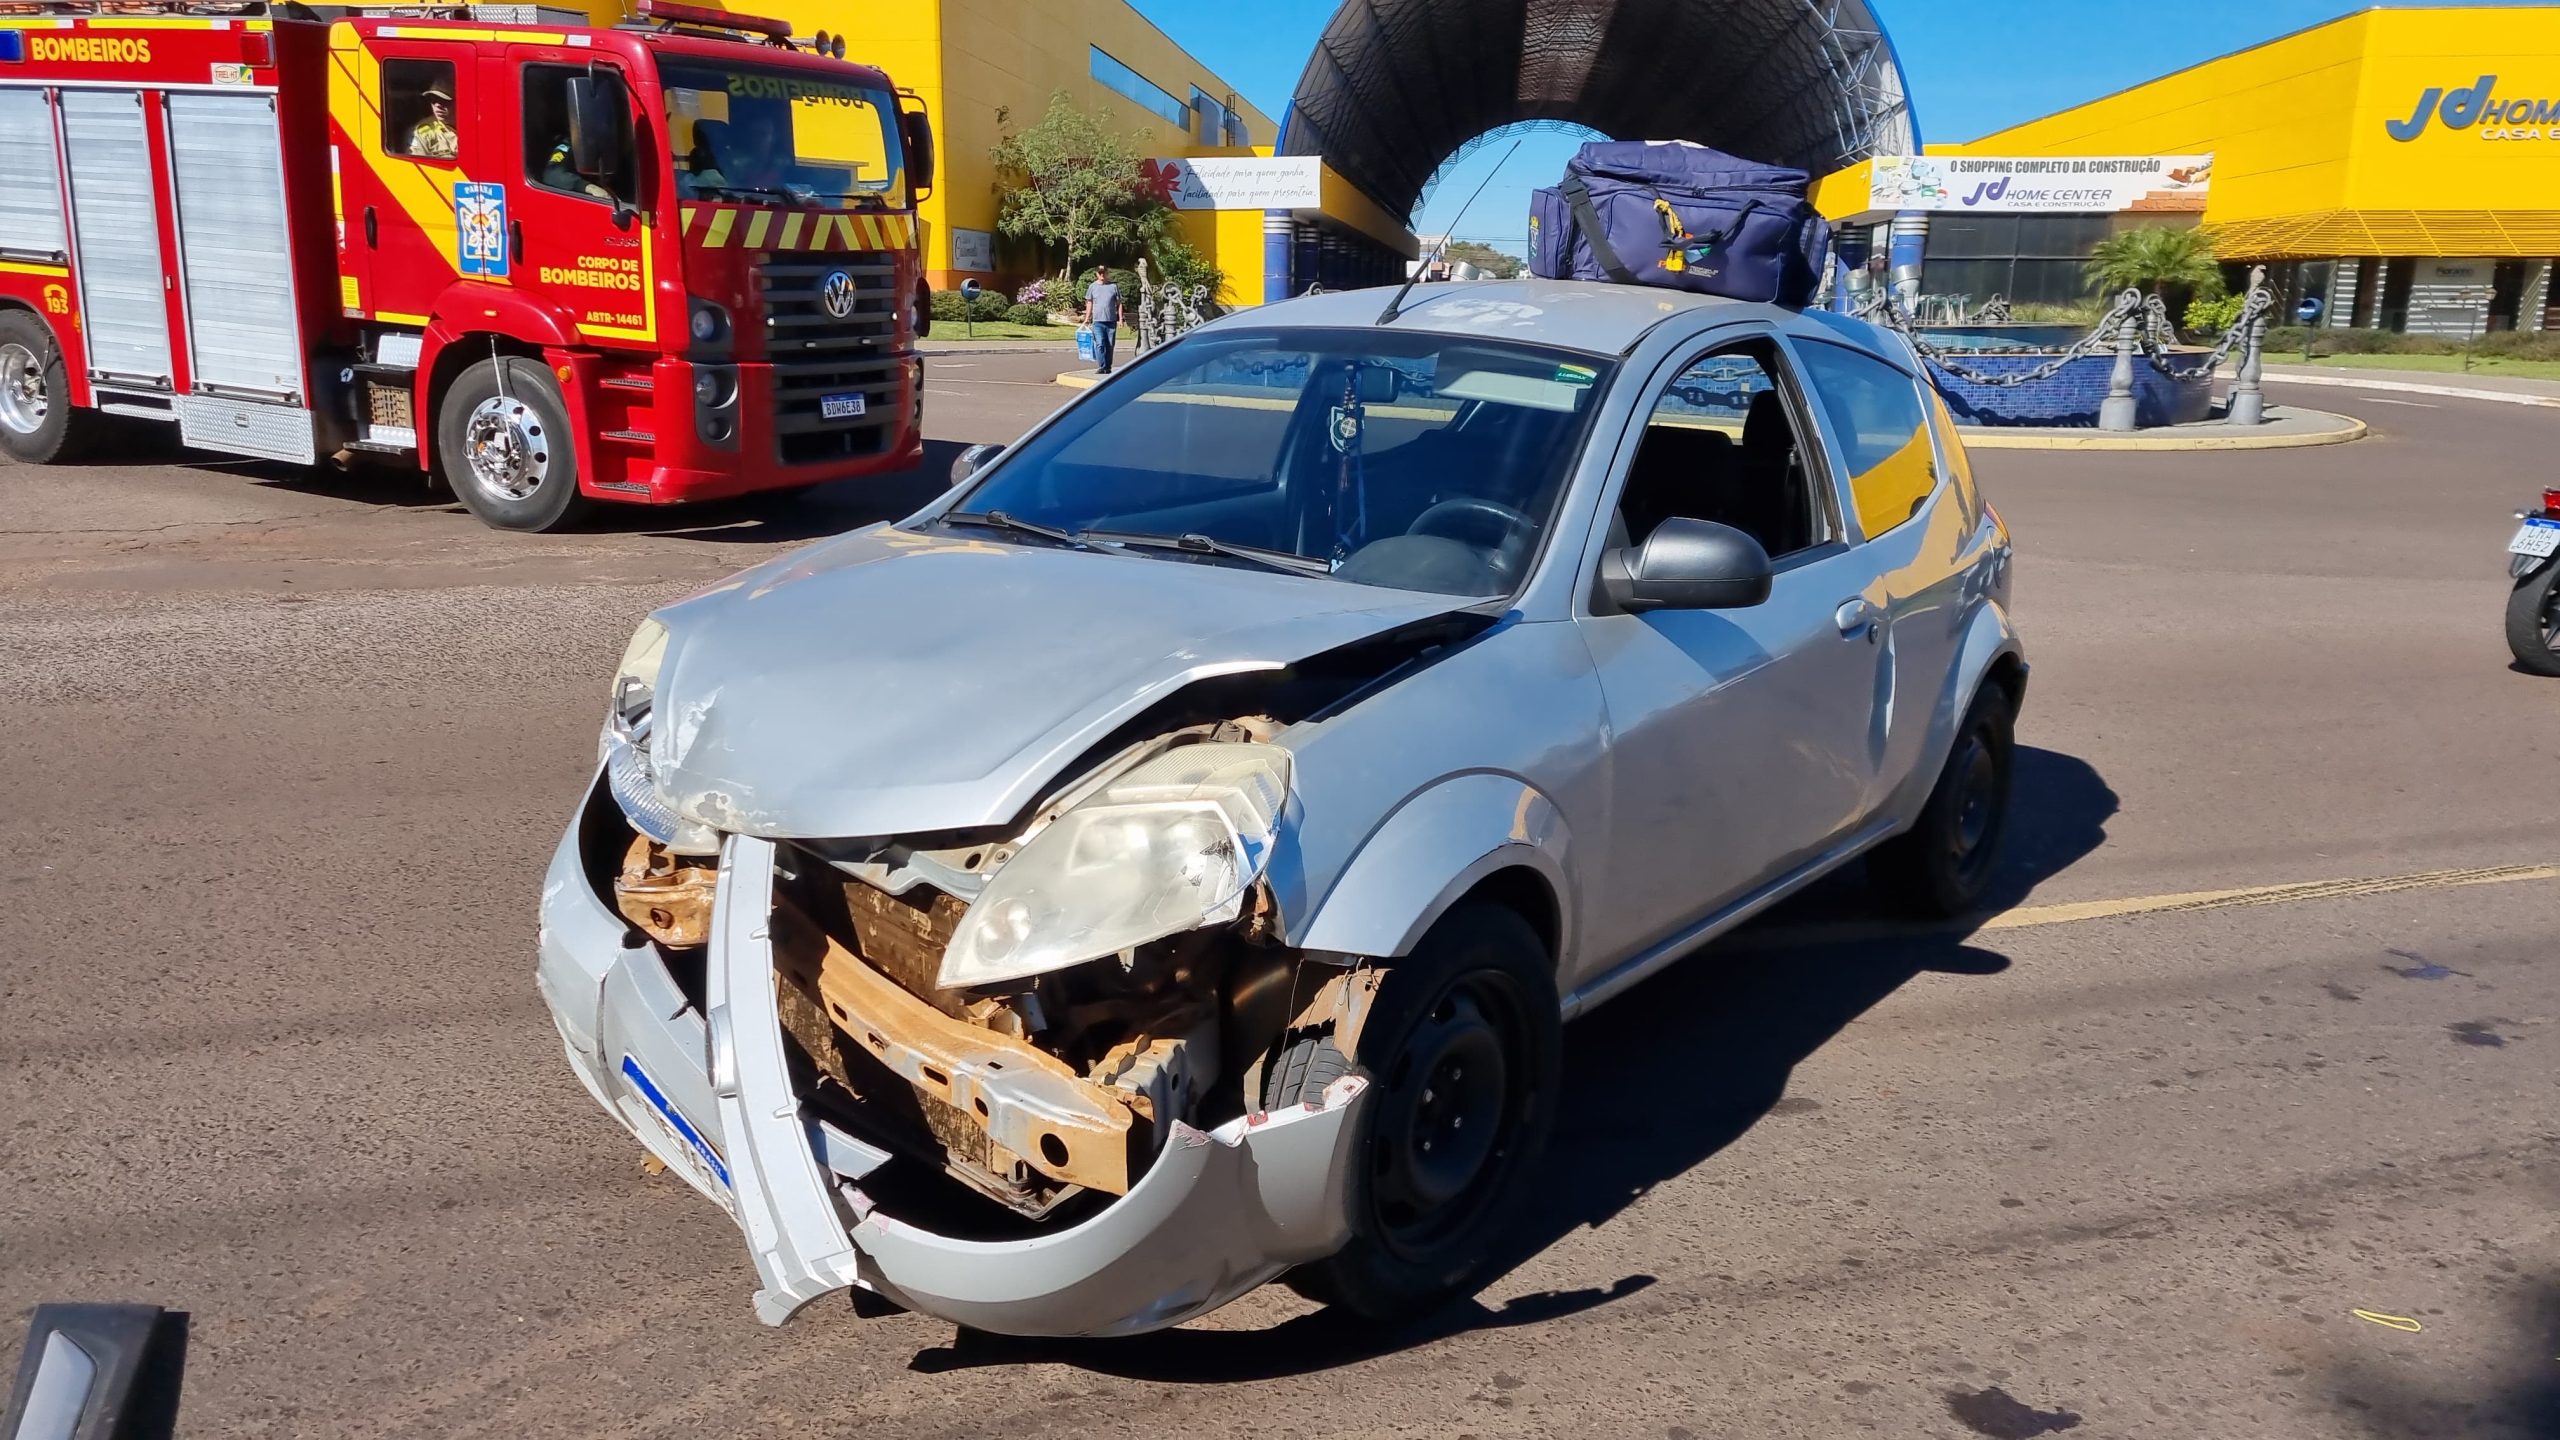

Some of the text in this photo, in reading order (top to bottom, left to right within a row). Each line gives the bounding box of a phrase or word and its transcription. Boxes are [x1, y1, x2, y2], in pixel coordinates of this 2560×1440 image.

[31, 37, 151, 64] BOMBEIROS
[2480, 128, 2542, 141] CASA
[1185, 164, 1230, 184] Felicidade
[1231, 169, 1252, 183] para
[1256, 170, 1276, 184] quem
[1950, 157, 2161, 175] O SHOPPING COMPLETO DA CONSTRUÇÃO
[1183, 185, 1224, 202] facilidade
[1225, 189, 1245, 204] para
[1249, 190, 1270, 204] quem
[2005, 189, 2050, 200] HOME
[2052, 189, 2112, 200] CENTER
[2042, 200, 2106, 208] CONSTRUÇÃO
[577, 255, 639, 272] CORPO DE
[540, 266, 641, 291] BOMBEIROS
[46, 297, 69, 314] 193
